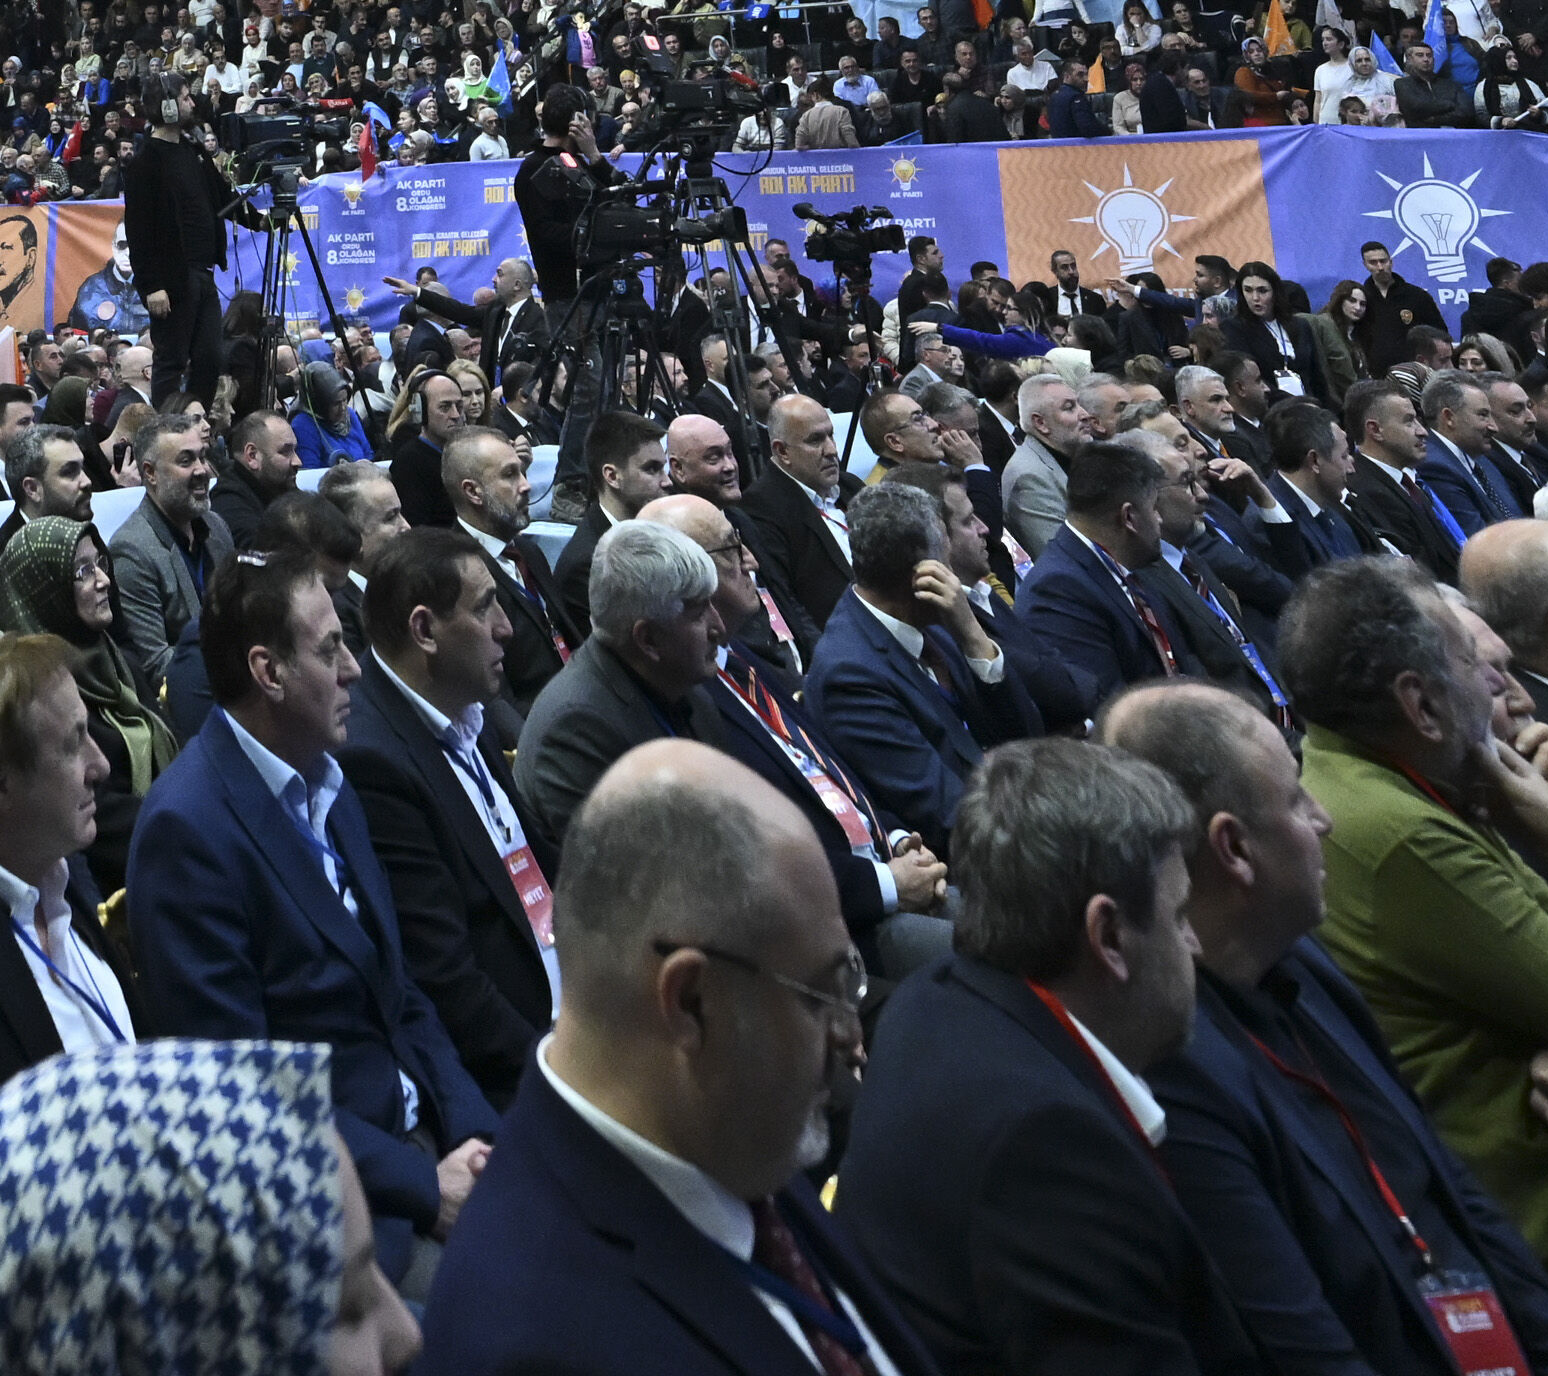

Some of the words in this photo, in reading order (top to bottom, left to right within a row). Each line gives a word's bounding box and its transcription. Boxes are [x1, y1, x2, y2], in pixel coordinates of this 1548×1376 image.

[396, 180, 412, 190] AK
[788, 175, 809, 194] AK
[411, 189, 431, 197] ORDU
[327, 233, 343, 243] AK
